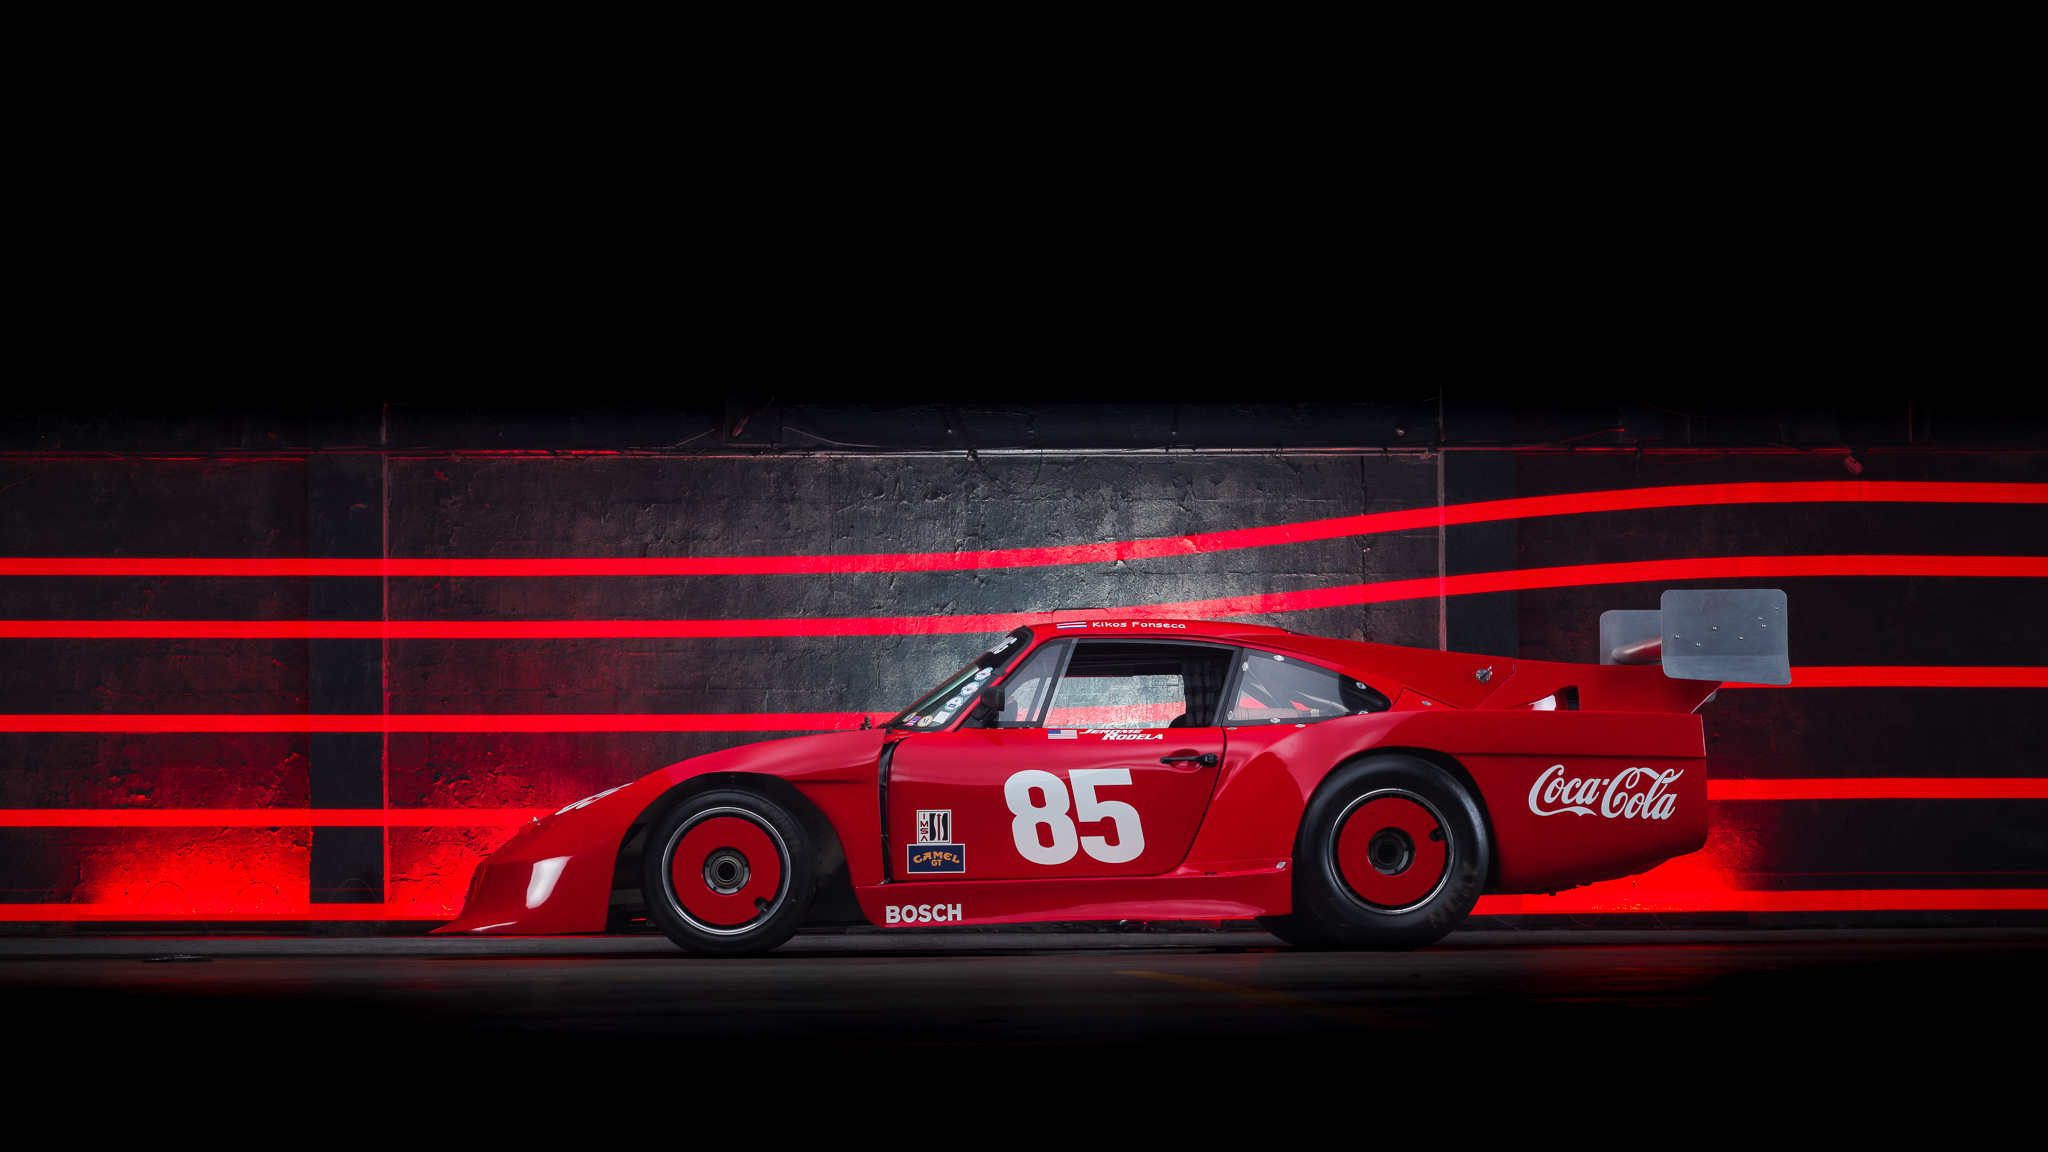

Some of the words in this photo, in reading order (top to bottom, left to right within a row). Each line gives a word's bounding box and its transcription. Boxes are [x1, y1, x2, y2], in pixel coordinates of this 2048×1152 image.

[1132, 621, 1186, 629] Fonseca
[1528, 764, 1684, 820] Coca-Cola
[919, 812, 929, 842] IMSA
[1003, 768, 1145, 865] 85
[912, 851, 960, 864] CAMEL
[930, 859, 942, 867] GT
[885, 903, 962, 924] BOSCH
